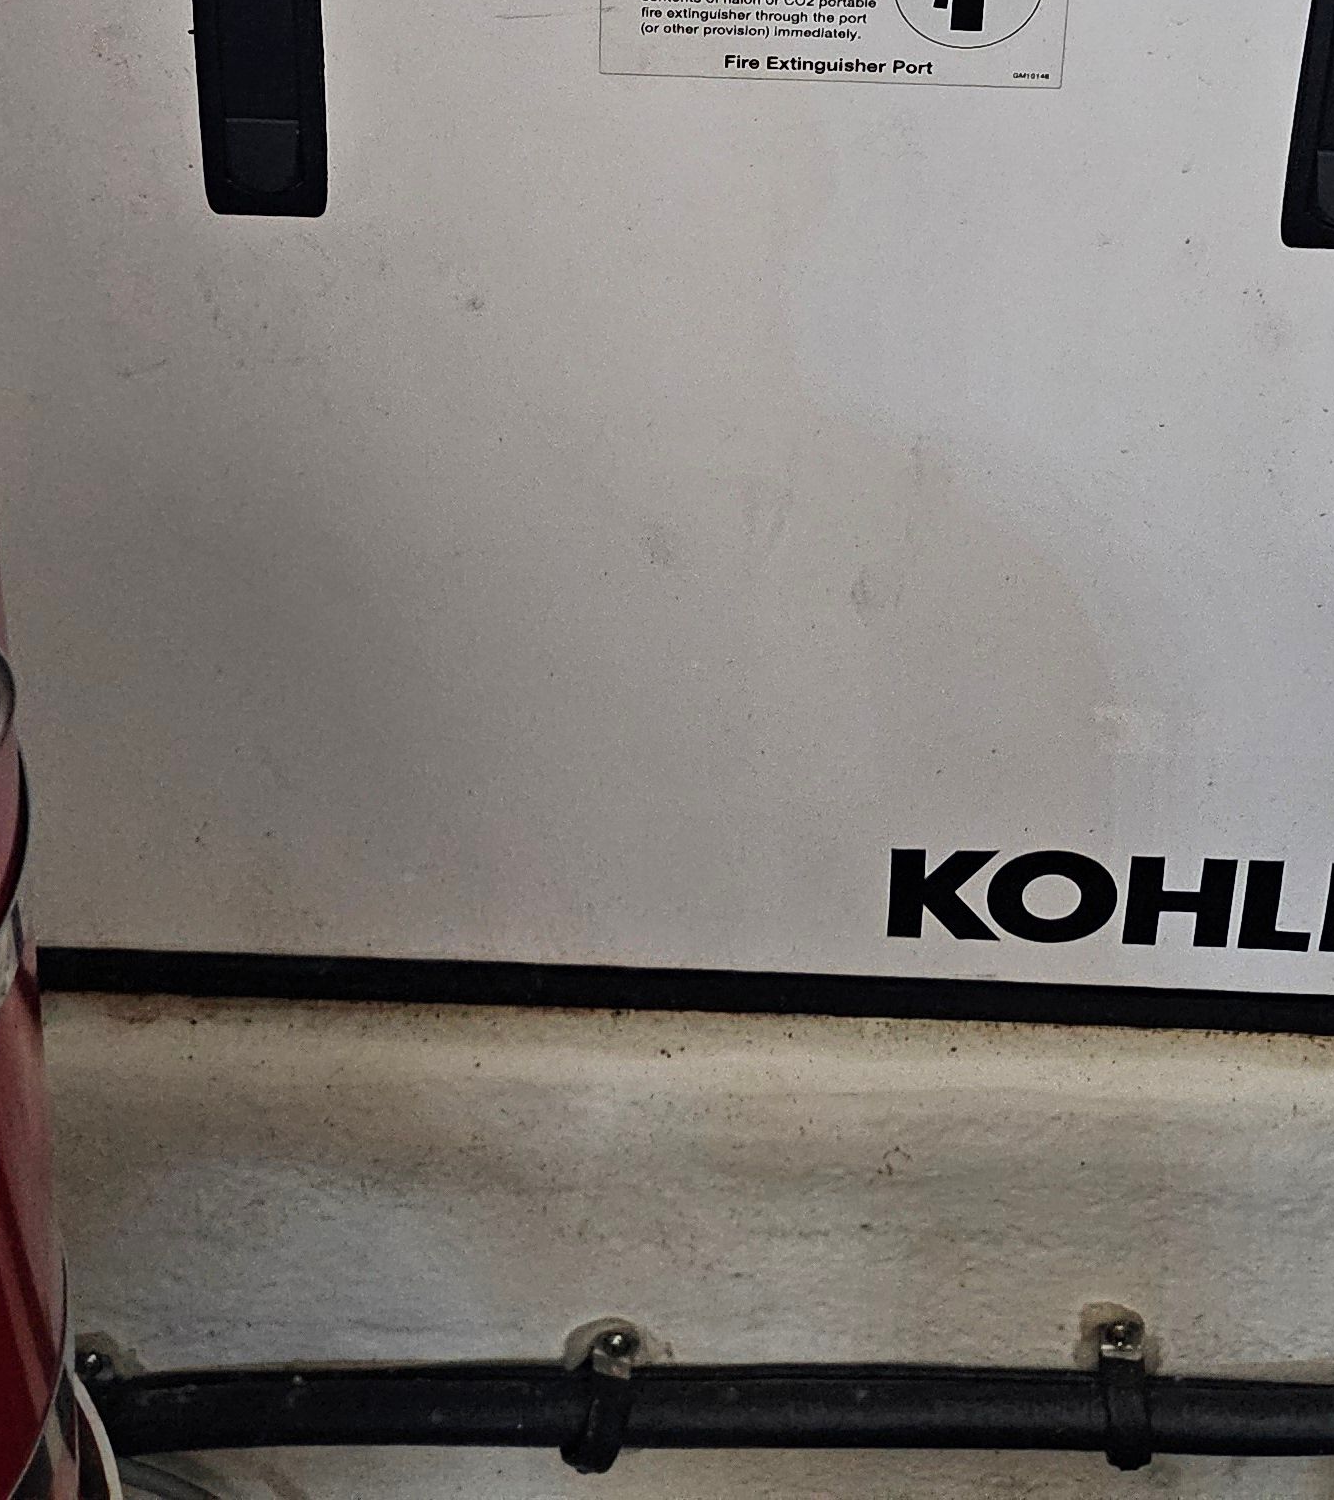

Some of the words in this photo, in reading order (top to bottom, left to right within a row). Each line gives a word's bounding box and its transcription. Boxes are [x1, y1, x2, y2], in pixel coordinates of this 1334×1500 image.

[641, 5, 663, 18] fire
[666, 6, 752, 23] extinguisher
[755, 8, 808, 25] through
[813, 10, 835, 24] the
[838, 12, 867, 26] port
[640, 20, 660, 36] (or
[663, 22, 700, 35] other
[703, 23, 770, 40] provision)
[774, 24, 862, 42] immediately.
[724, 53, 760, 70] Fire
[766, 54, 887, 75] Extinguisher
[892, 58, 934, 75] Port
